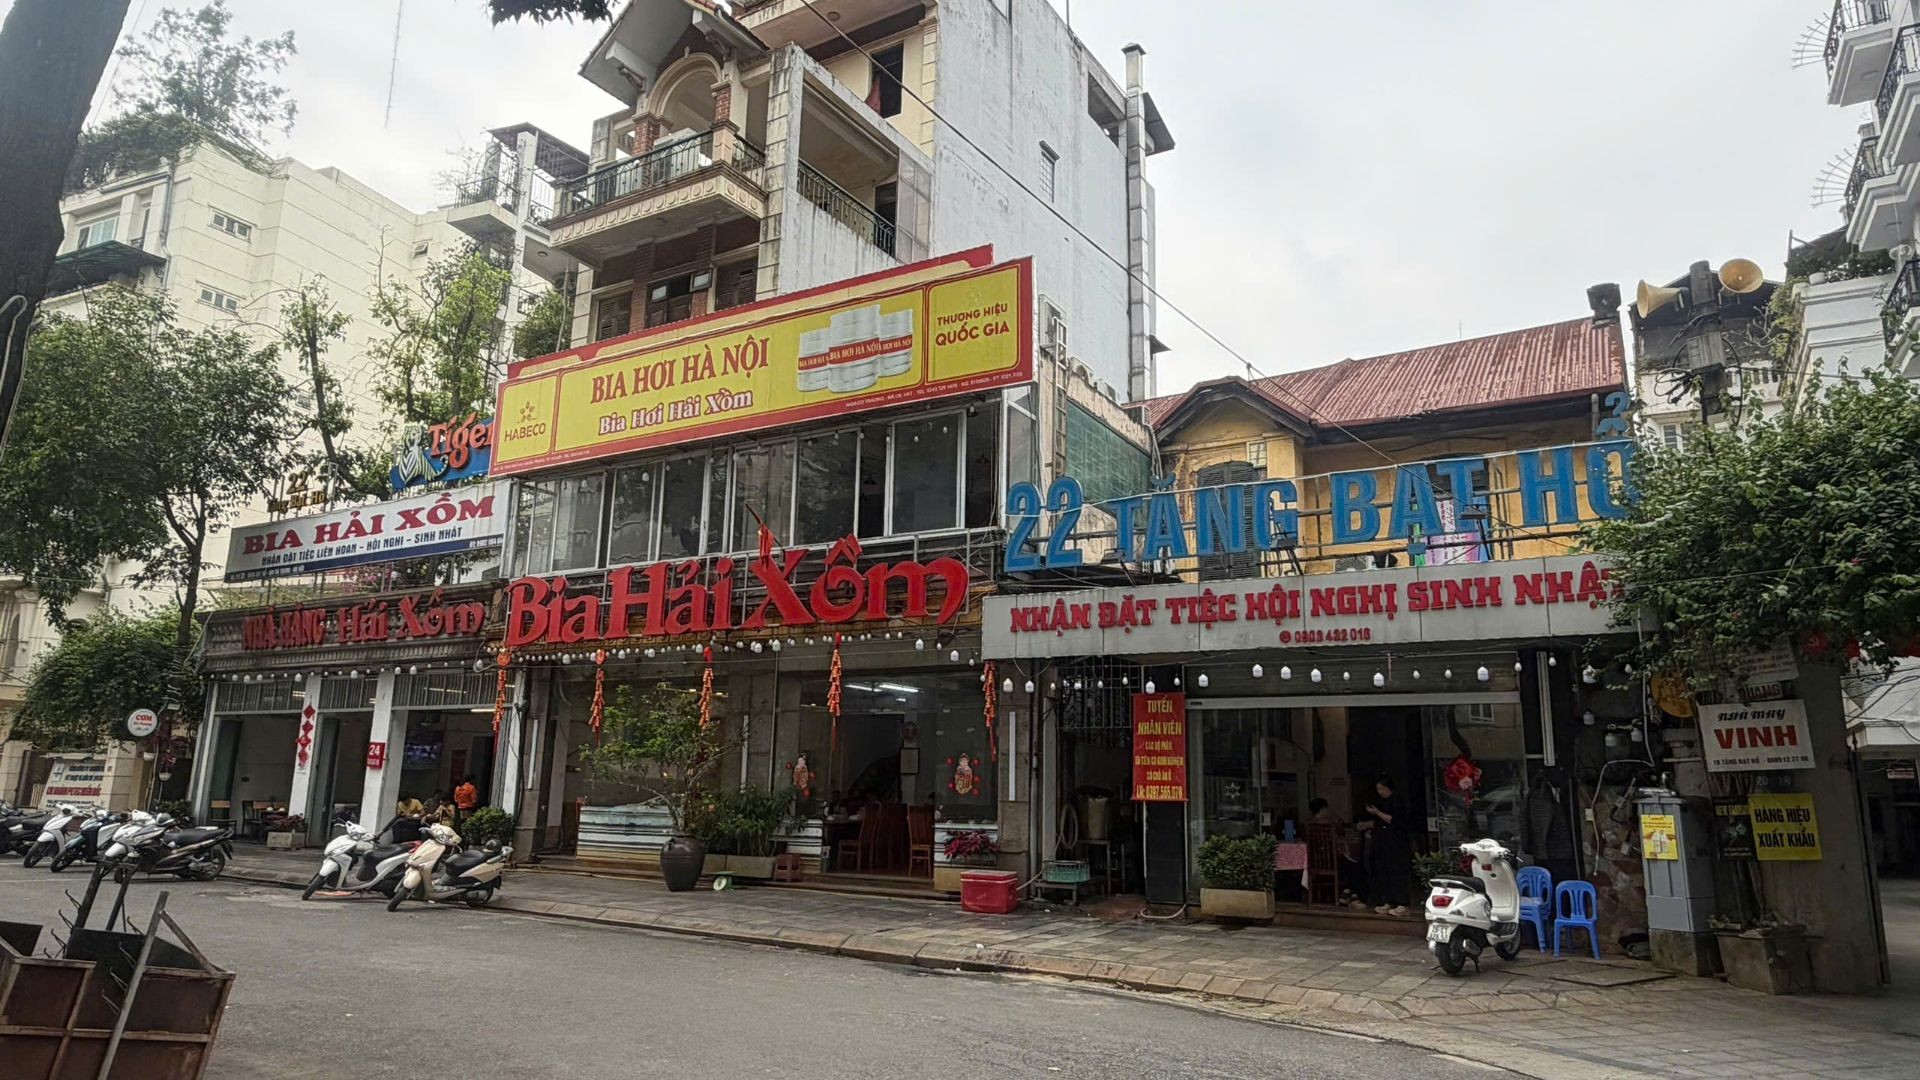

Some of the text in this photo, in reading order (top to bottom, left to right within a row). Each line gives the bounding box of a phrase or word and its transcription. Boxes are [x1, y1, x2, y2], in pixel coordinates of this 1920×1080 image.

[937, 302, 1008, 325] THƯƠNG HIỆU
[935, 321, 1010, 347] QUỐC GIA
[590, 334, 770, 404] BIA HƠI HÀ NỘI
[598, 413, 626, 436] Bia
[631, 403, 664, 429] Hơi
[705, 388, 752, 415] Xồm
[428, 411, 493, 469] Tiger
[504, 422, 547, 442] HABECO
[286, 472, 308, 494] 22
[1004, 391, 1640, 573] 22 TĂNG BẠT HỔ
[242, 492, 496, 555] BIA HẢI XỒM
[335, 543, 357, 555] HOAN
[414, 530, 436, 544] SINH
[505, 533, 970, 648] Bia Hải Xồm
[1010, 598, 1091, 638] NHẬN
[1098, 595, 1157, 634] ĐẶT
[1165, 587, 1237, 629] TIỆC
[1245, 583, 1301, 626] HỘI
[1310, 582, 1397, 620] NGHỊ
[1407, 575, 1502, 611] SINH
[243, 605, 277, 650] NHÀ
[279, 602, 327, 647] HÀNG
[337, 598, 388, 643] Hải
[1138, 719, 1182, 736] NHÂN VIÊN
[1713, 724, 1799, 750] VINH
[369, 744, 380, 756] 24
[1755, 805, 1785, 823] HÀNG
[1786, 805, 1811, 826] HIỆU
[1757, 826, 1816, 848] XUẤT KHẨU
